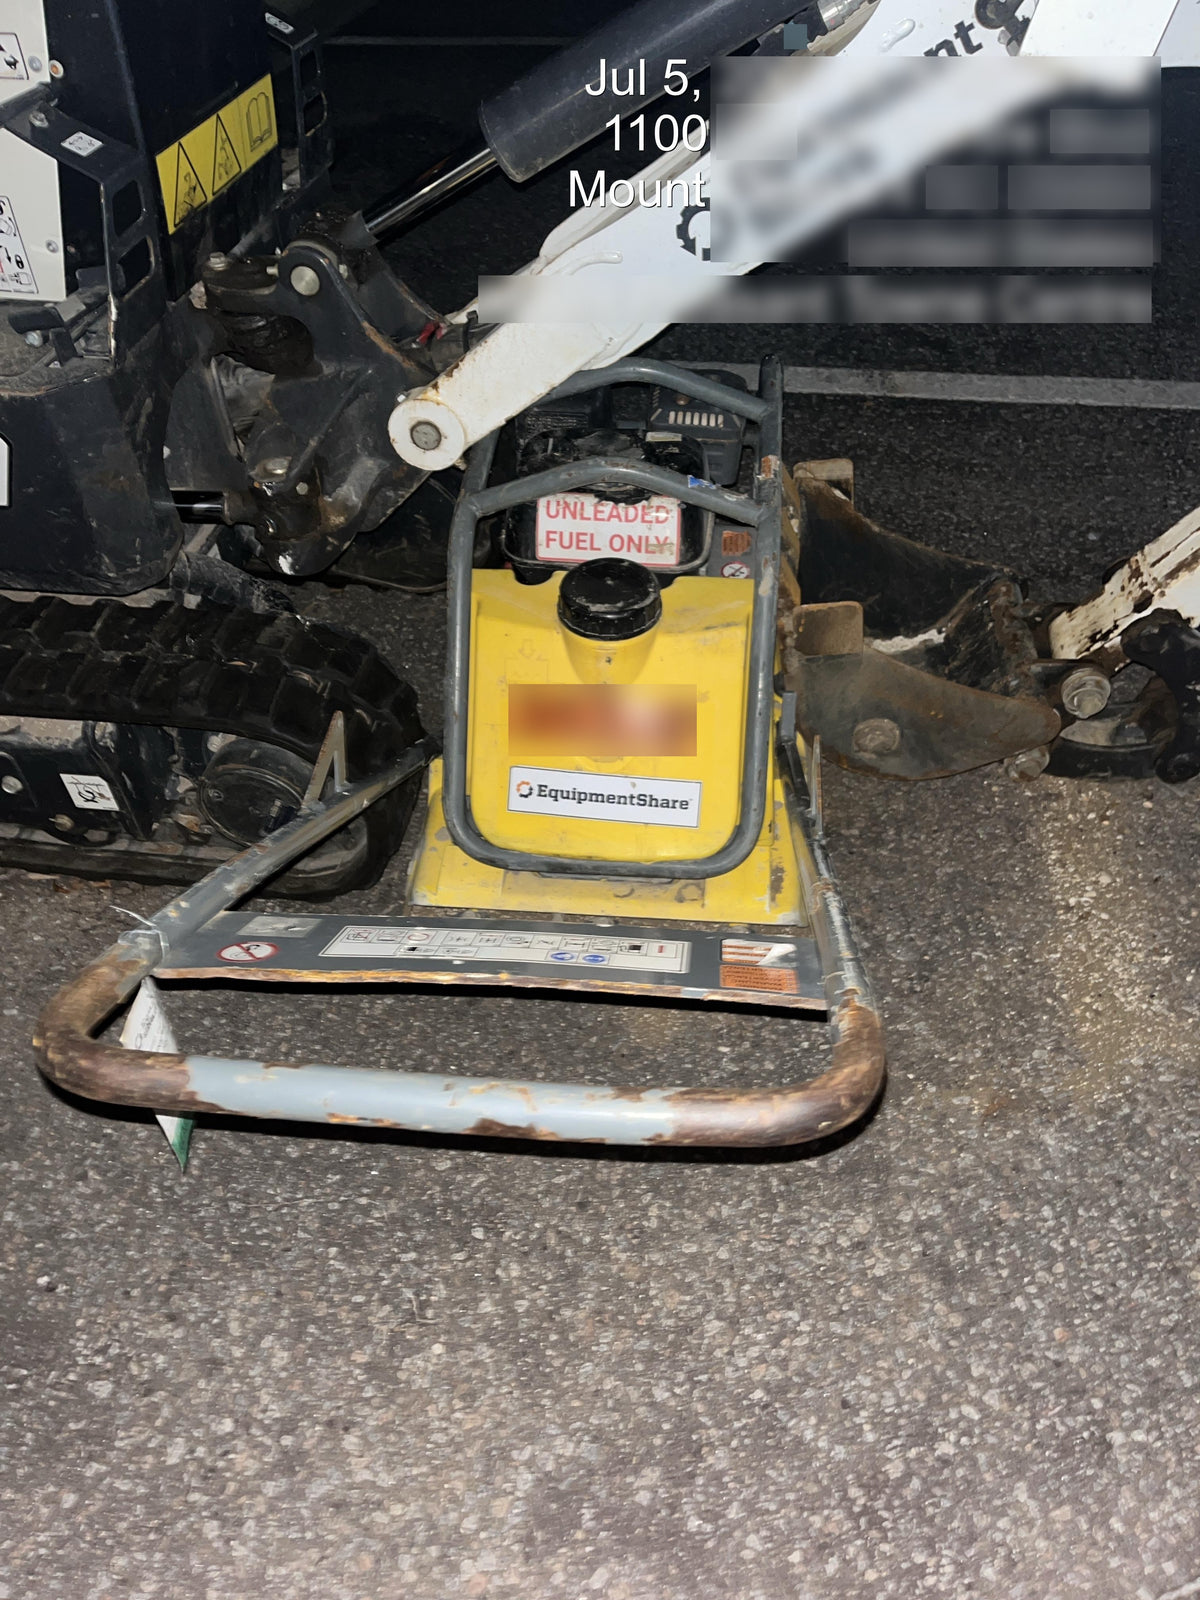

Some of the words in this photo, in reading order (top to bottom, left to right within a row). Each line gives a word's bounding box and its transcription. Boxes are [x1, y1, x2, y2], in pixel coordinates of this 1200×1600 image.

[545, 499, 671, 524] UNLEADED
[545, 530, 602, 551] FUEL
[608, 533, 670, 555] ONLY
[537, 784, 690, 810] EquipmentShare
